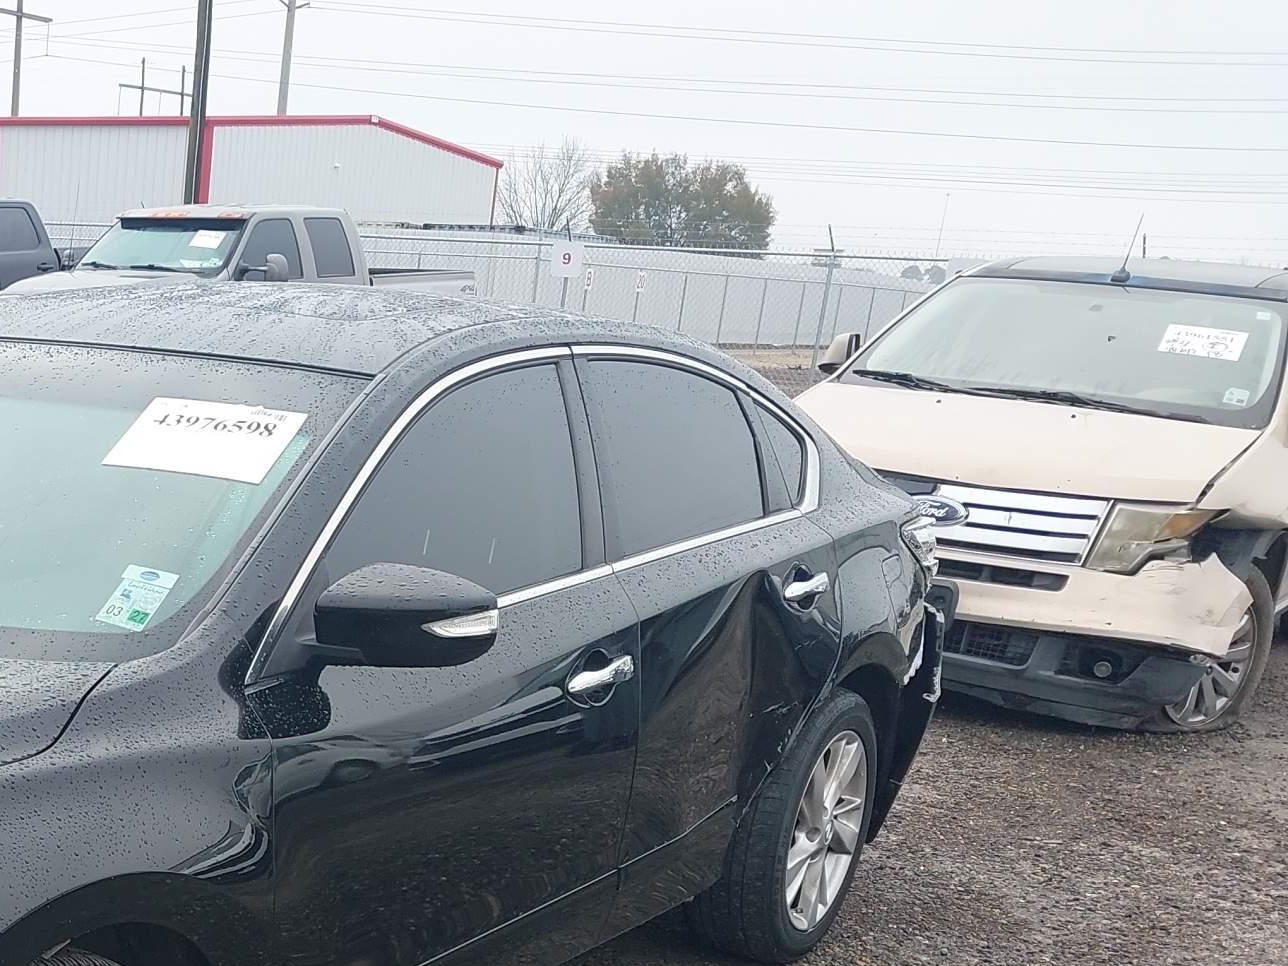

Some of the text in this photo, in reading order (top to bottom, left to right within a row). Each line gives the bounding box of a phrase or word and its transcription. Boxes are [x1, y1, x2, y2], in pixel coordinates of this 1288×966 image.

[562, 253, 572, 265] 9
[153, 413, 277, 437] 43976598
[918, 500, 949, 517] Ford
[106, 604, 124, 617] 03
[131, 610, 150, 624] 27
